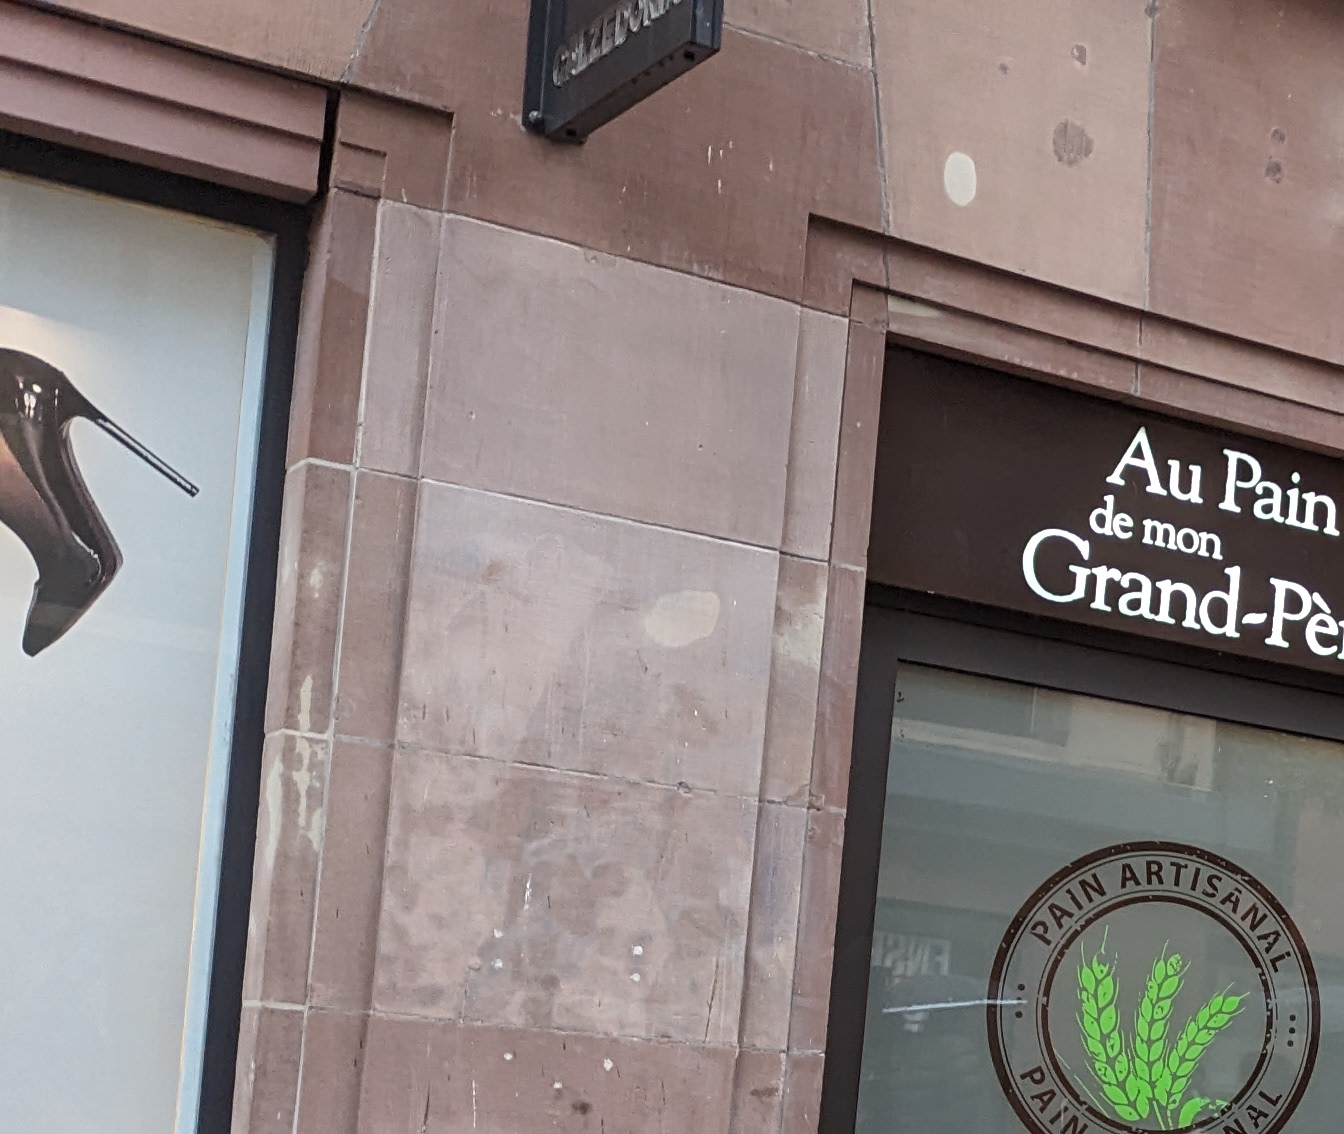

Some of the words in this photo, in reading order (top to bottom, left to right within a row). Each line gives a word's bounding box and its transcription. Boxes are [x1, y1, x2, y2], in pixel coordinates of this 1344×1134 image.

[1089, 495, 1134, 539] de
[1142, 518, 1223, 560] mon
[1106, 426, 1203, 503] Au
[1218, 448, 1340, 536] Pain
[1030, 872, 1107, 946] PAIN
[1119, 859, 1292, 974] ARTISANAL
